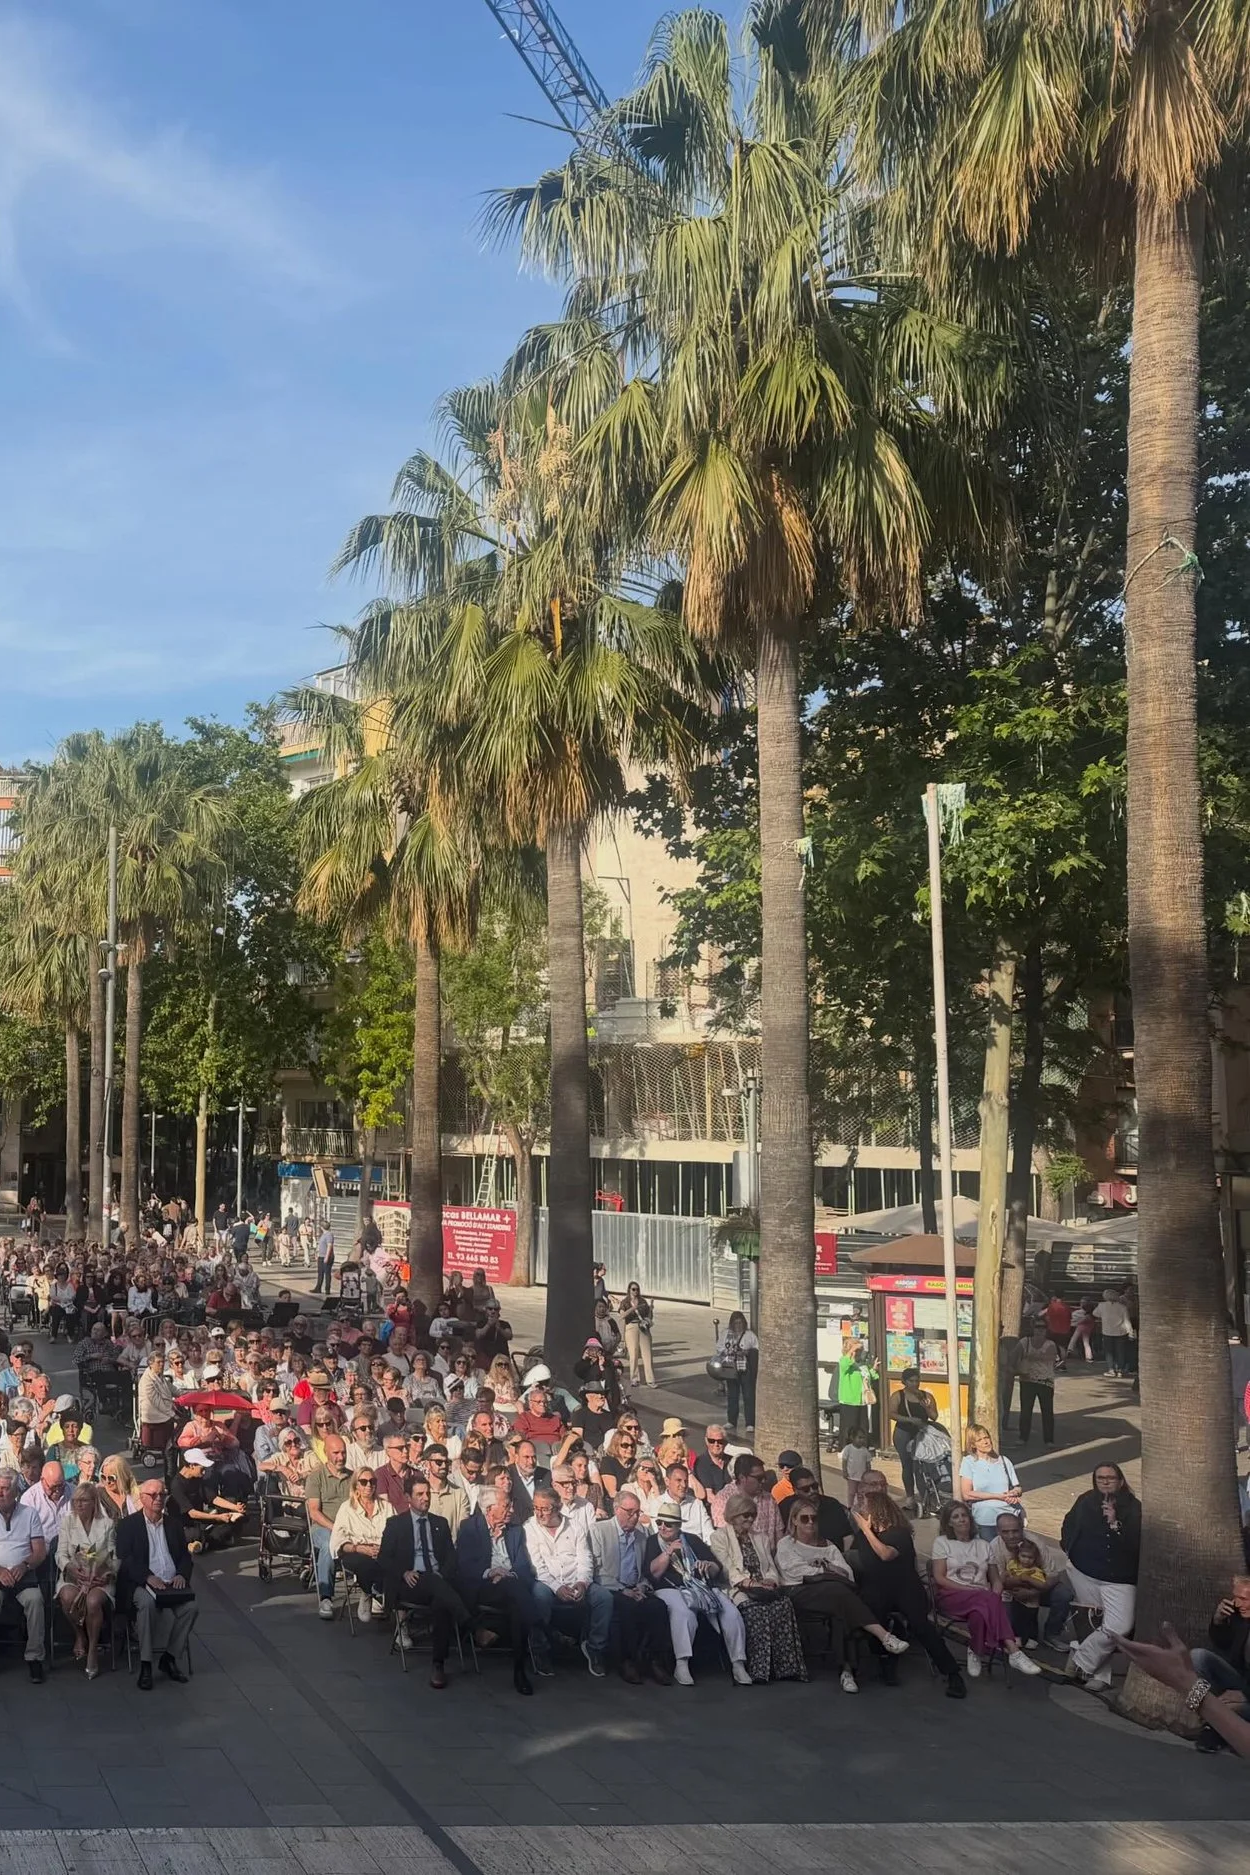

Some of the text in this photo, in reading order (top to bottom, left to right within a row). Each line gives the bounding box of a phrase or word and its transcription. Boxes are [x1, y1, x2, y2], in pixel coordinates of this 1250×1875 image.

[442, 1211, 501, 1222] ncas BELLAMAR
[448, 1219, 473, 1228] PROMOCIÓ
[456, 1252, 465, 1261] 93
